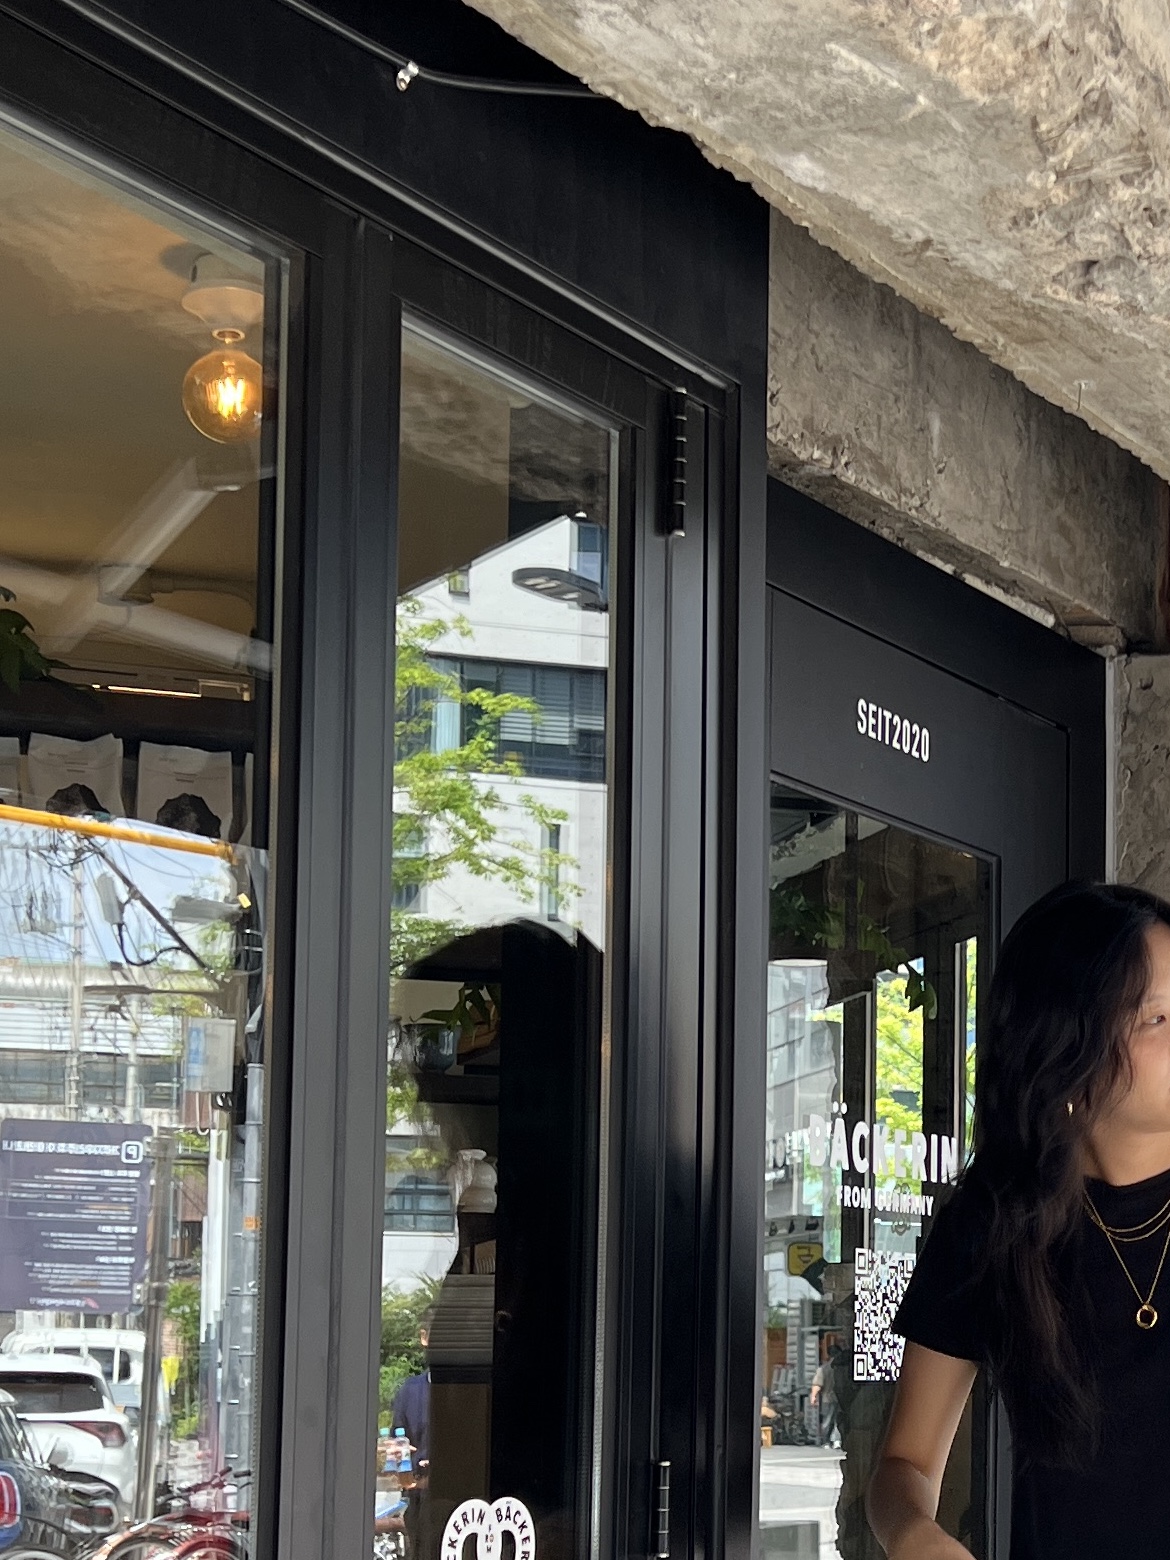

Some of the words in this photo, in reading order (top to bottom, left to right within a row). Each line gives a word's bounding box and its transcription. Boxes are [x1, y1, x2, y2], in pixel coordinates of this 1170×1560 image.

[857, 698, 930, 763] SEIT2020
[808, 1101, 959, 1186] BÄCKERIN
[837, 1185, 872, 1210] FROM
[874, 1192, 934, 1217] GERMANY
